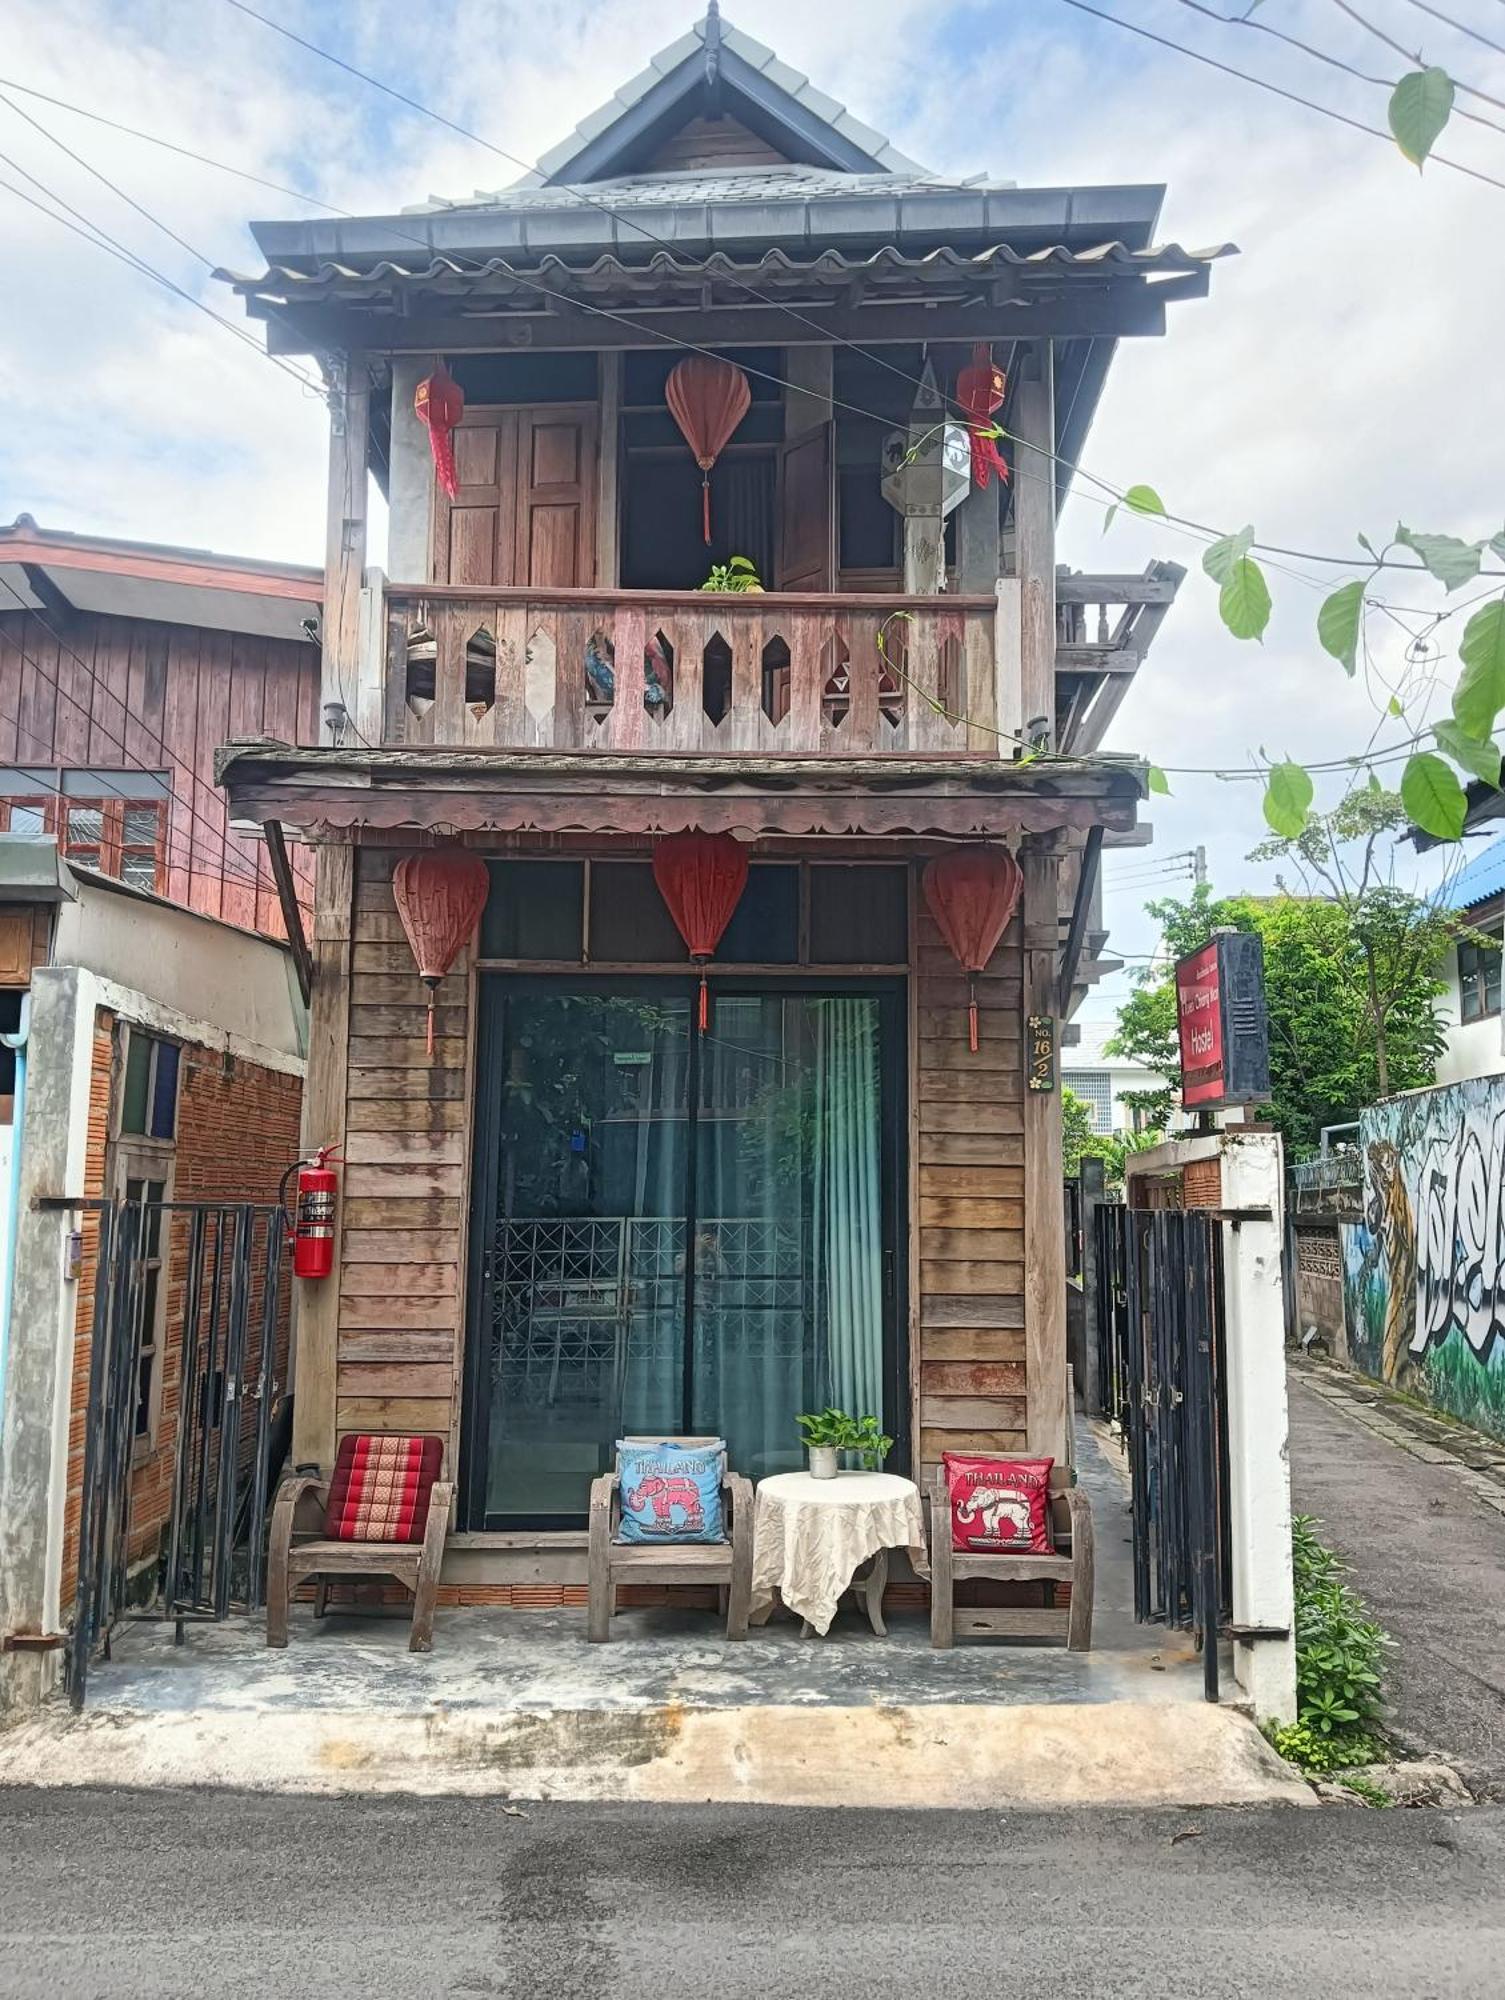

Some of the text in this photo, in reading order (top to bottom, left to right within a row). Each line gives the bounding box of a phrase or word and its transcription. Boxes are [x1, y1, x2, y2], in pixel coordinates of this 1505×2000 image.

[1191, 1018, 1214, 1055] Hostel
[635, 1460, 705, 1475] THAILAND
[965, 1472, 1041, 1489] THAILAND
